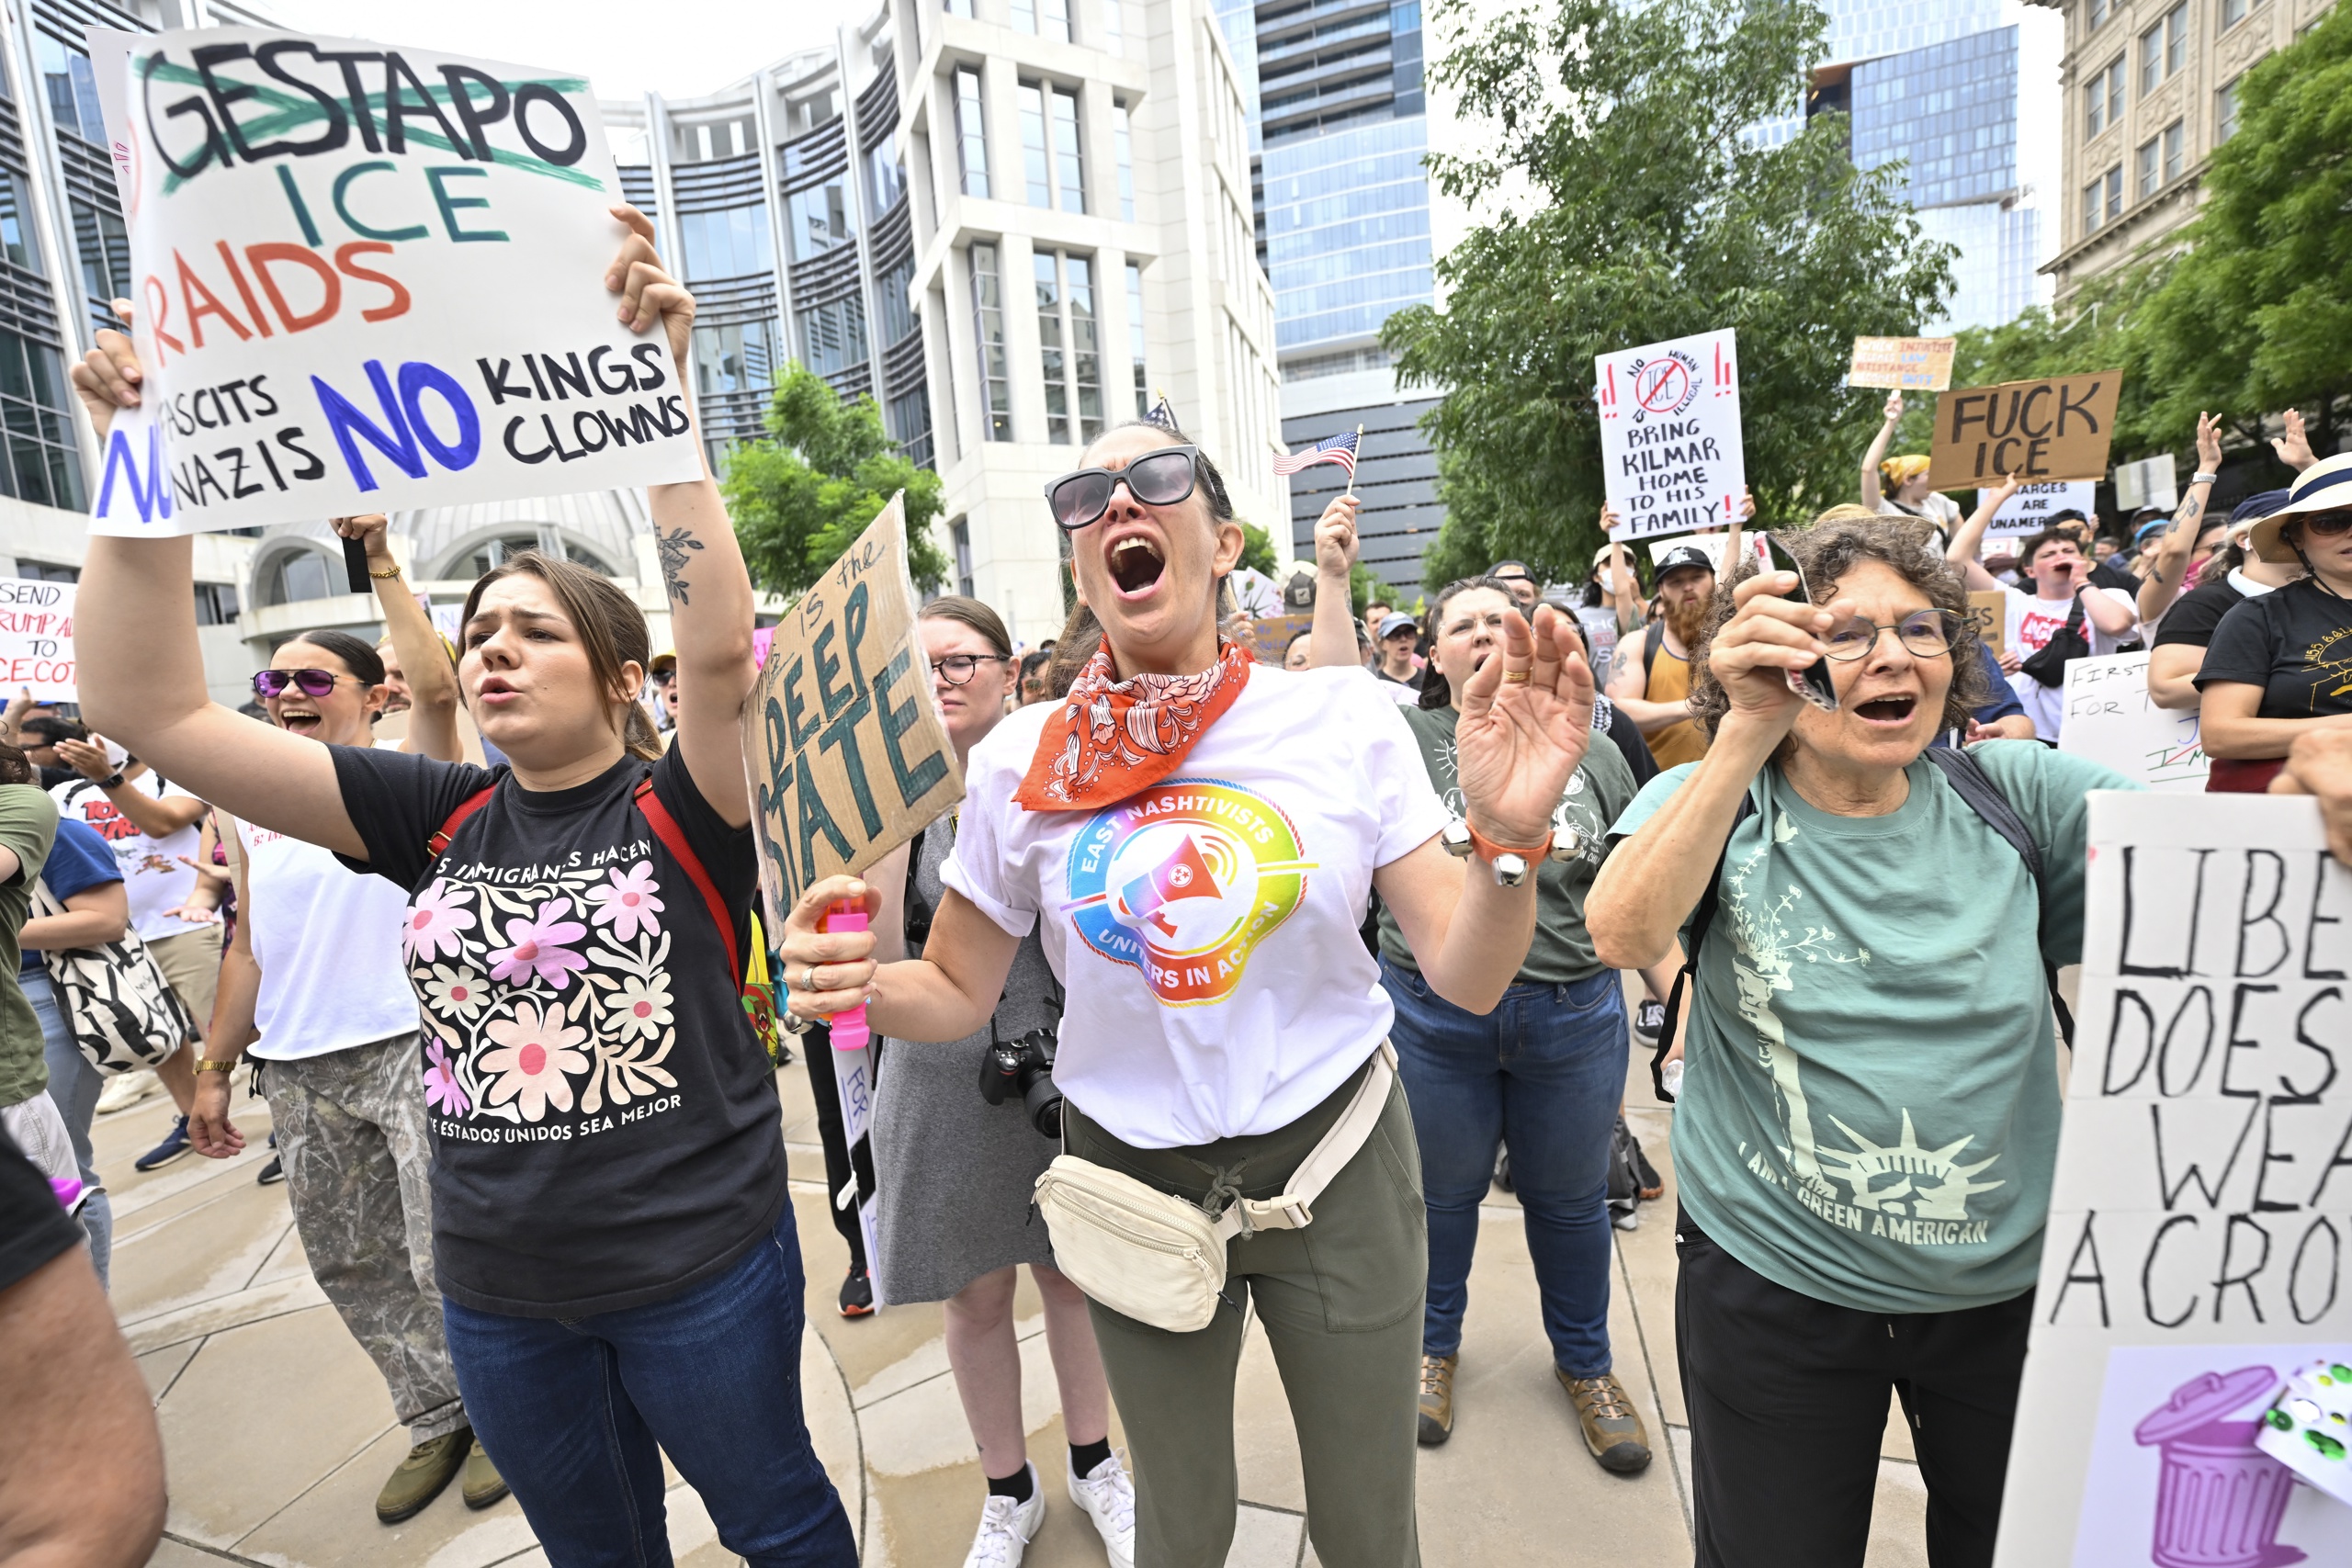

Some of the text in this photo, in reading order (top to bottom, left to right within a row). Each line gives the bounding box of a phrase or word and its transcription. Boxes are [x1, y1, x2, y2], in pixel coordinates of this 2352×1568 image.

[144, 39, 587, 178] GESTAPO
[277, 161, 510, 247] ICE
[145, 240, 412, 367] RAIDS
[476, 344, 665, 406] KINGS
[1626, 349, 1700, 378] NO HUMAN
[1632, 378, 1702, 423] IS ILLEGAL
[1951, 382, 2100, 444] FUCK
[310, 360, 481, 492] NO
[503, 395, 689, 464] CLOWNS
[1627, 418, 1701, 449] BRING
[172, 426, 325, 511] NAZIS
[1623, 436, 1721, 477] KILMAR
[1639, 467, 1709, 491] HOME
[1975, 436, 2050, 478] ICE
[1624, 486, 1705, 512] TO HIS
[2016, 481, 2067, 495] ARGES
[2021, 499, 2049, 511] ARE
[837, 541, 885, 589] the
[0, 582, 61, 607] SEND
[0, 610, 57, 636] RUMP
[27, 638, 57, 658] TO
[765, 581, 870, 784] DEEP
[2072, 663, 2149, 687] FIRST
[2071, 695, 2124, 719] FOR
[759, 647, 949, 922] STATE
[591, 840, 652, 866] HACEN
[1080, 795, 1275, 874] EAST NASHTIVISTS
[1185, 967, 1212, 987] IN
[2100, 982, 2344, 1098] DOES
[440, 1120, 501, 1144] ESTADOS
[504, 1124, 573, 1144] UNIDOS
[580, 1118, 615, 1136] SEA
[620, 1094, 682, 1125] MEJOR
[847, 1066, 869, 1130] FOR
[1797, 1186, 1862, 1232] GREEN
[1871, 1218, 1988, 1247] AMERICAN
[2142, 1213, 2352, 1329] CRO
